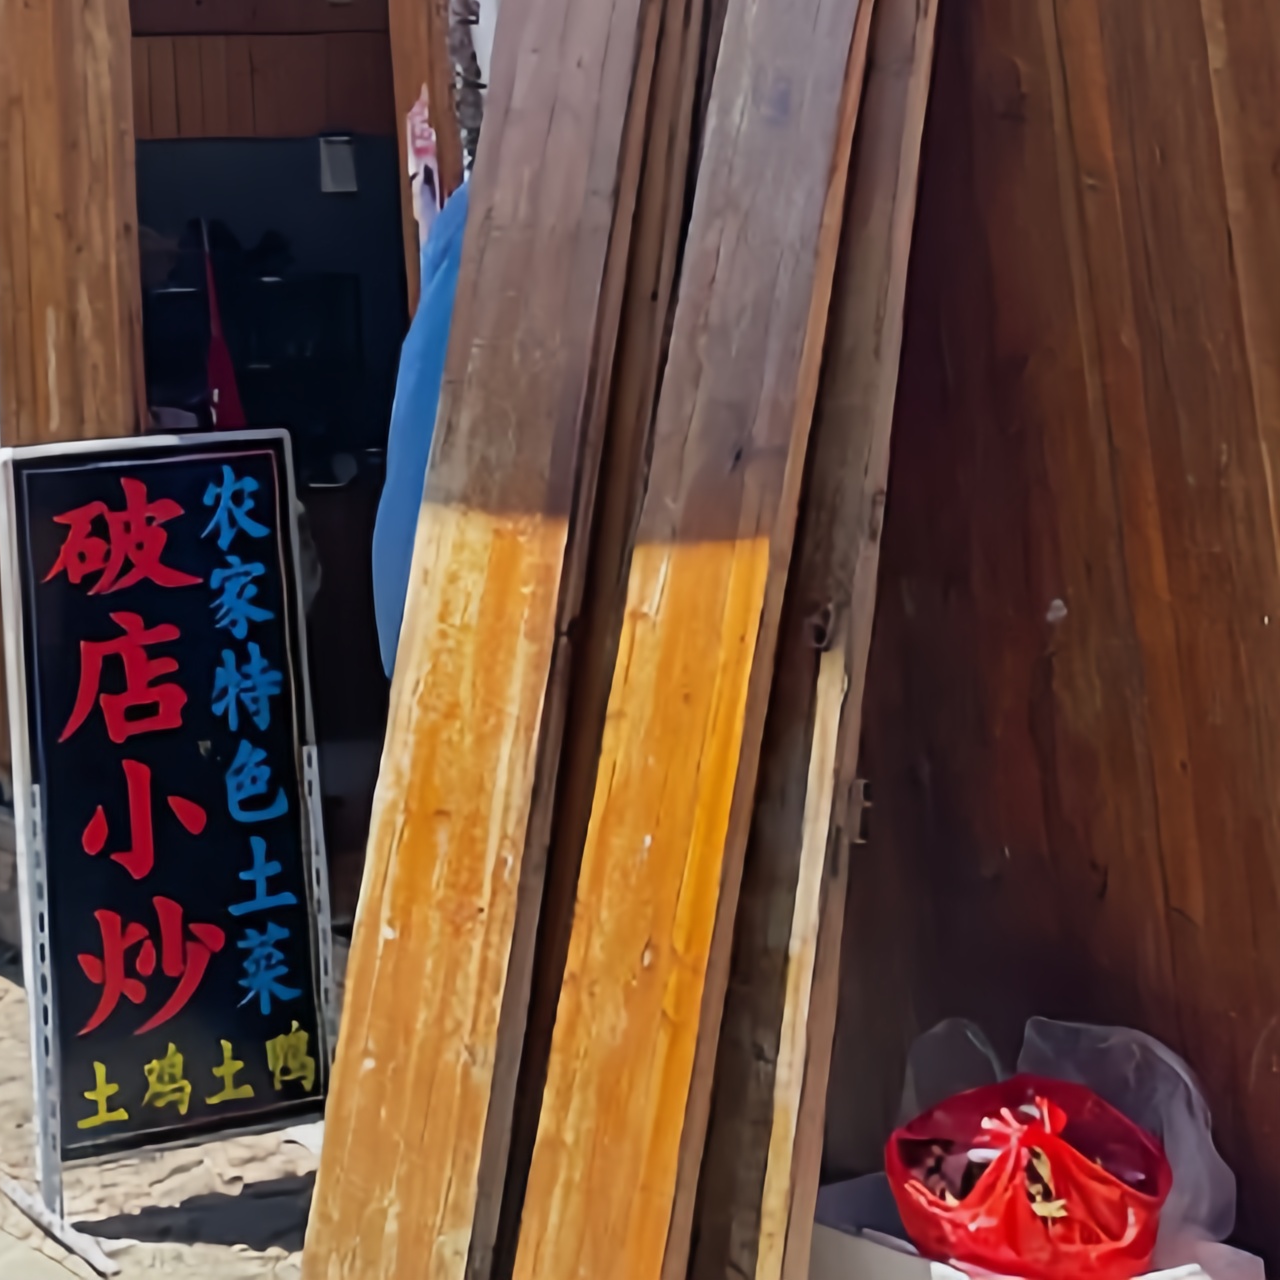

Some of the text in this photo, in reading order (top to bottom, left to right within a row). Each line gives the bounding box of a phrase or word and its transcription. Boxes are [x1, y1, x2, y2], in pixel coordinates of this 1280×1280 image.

[41, 477, 227, 1038] 破店小炒
[200, 463, 302, 1016] 农家特色土菜
[75, 1019, 317, 1130] 土鸡土鸭
